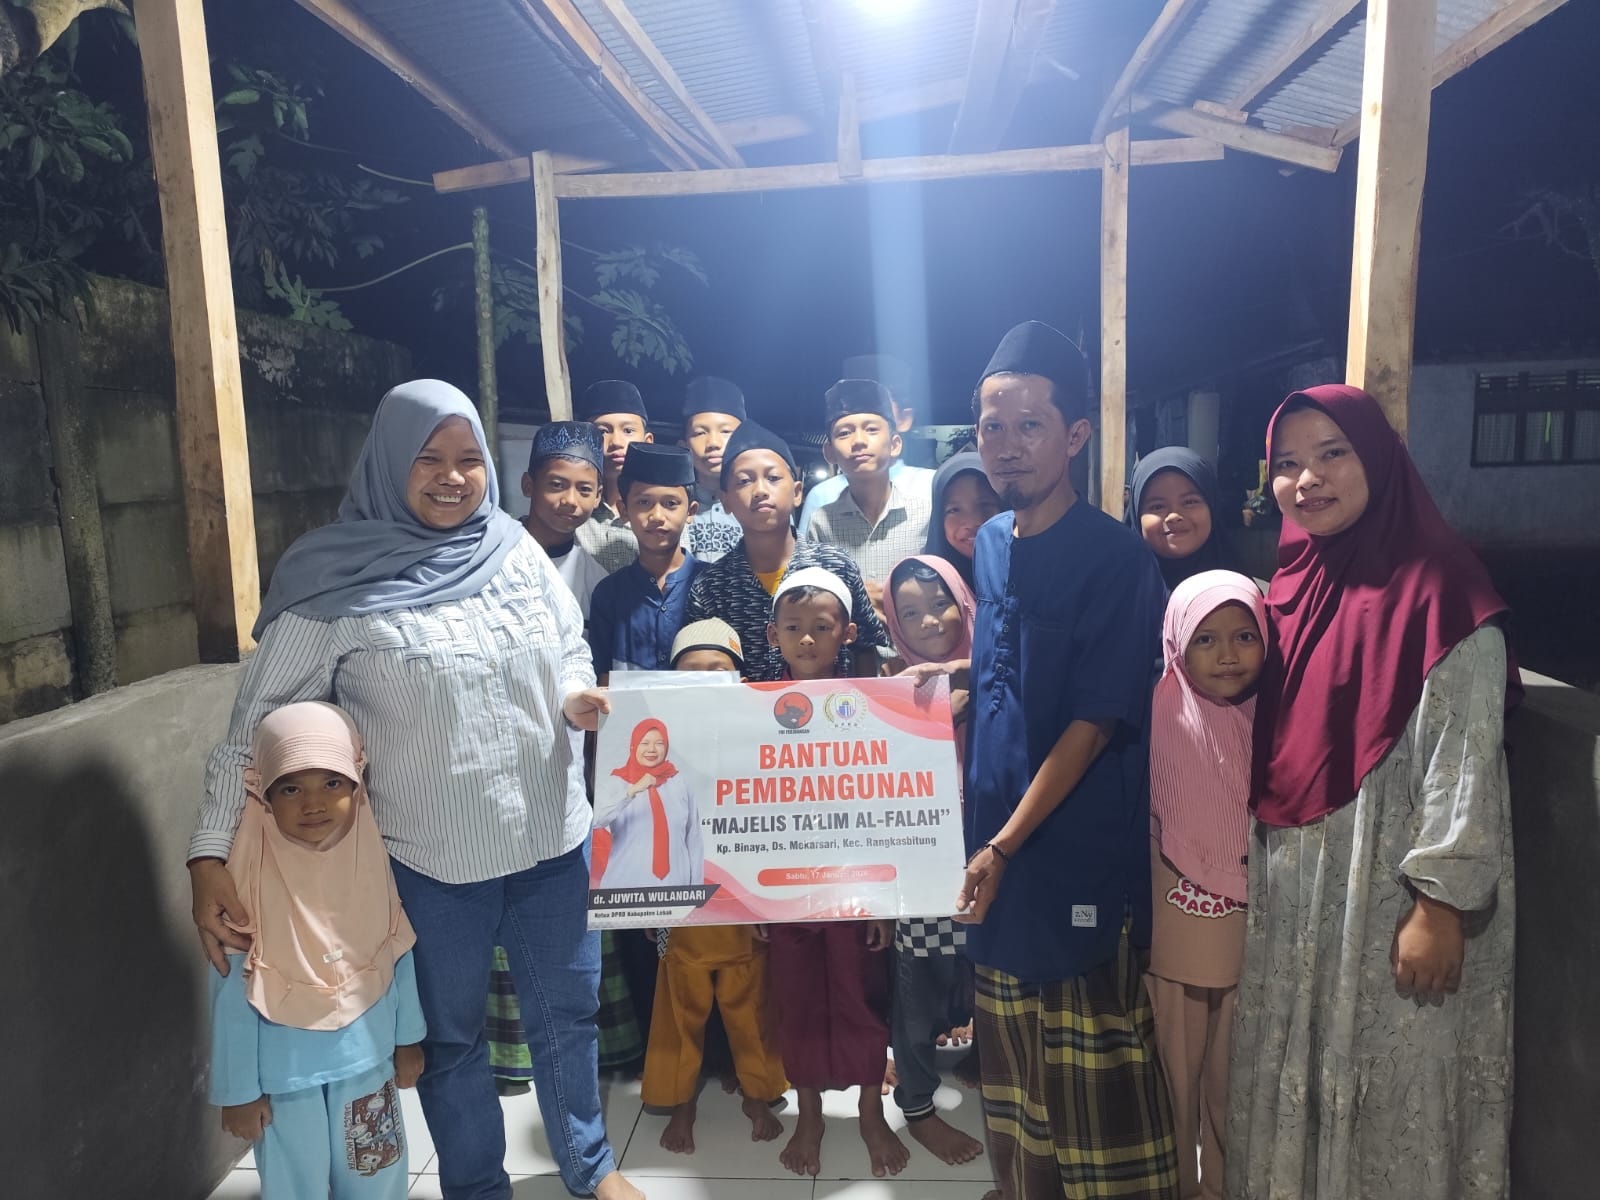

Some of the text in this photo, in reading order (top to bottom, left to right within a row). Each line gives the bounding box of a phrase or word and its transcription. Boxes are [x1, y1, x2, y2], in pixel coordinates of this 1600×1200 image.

[759, 739, 888, 770] BANTUAN
[716, 770, 935, 806] PEMBANGUNAN
[701, 814, 787, 835] “MAJELIS
[855, 808, 951, 829] AL-FALAH”
[716, 836, 937, 855] Kp. Binaya, Ds. Mekarsari, Kec. Rangkasbitung
[593, 890, 706, 905] dr. JUWITA WULANDARI
